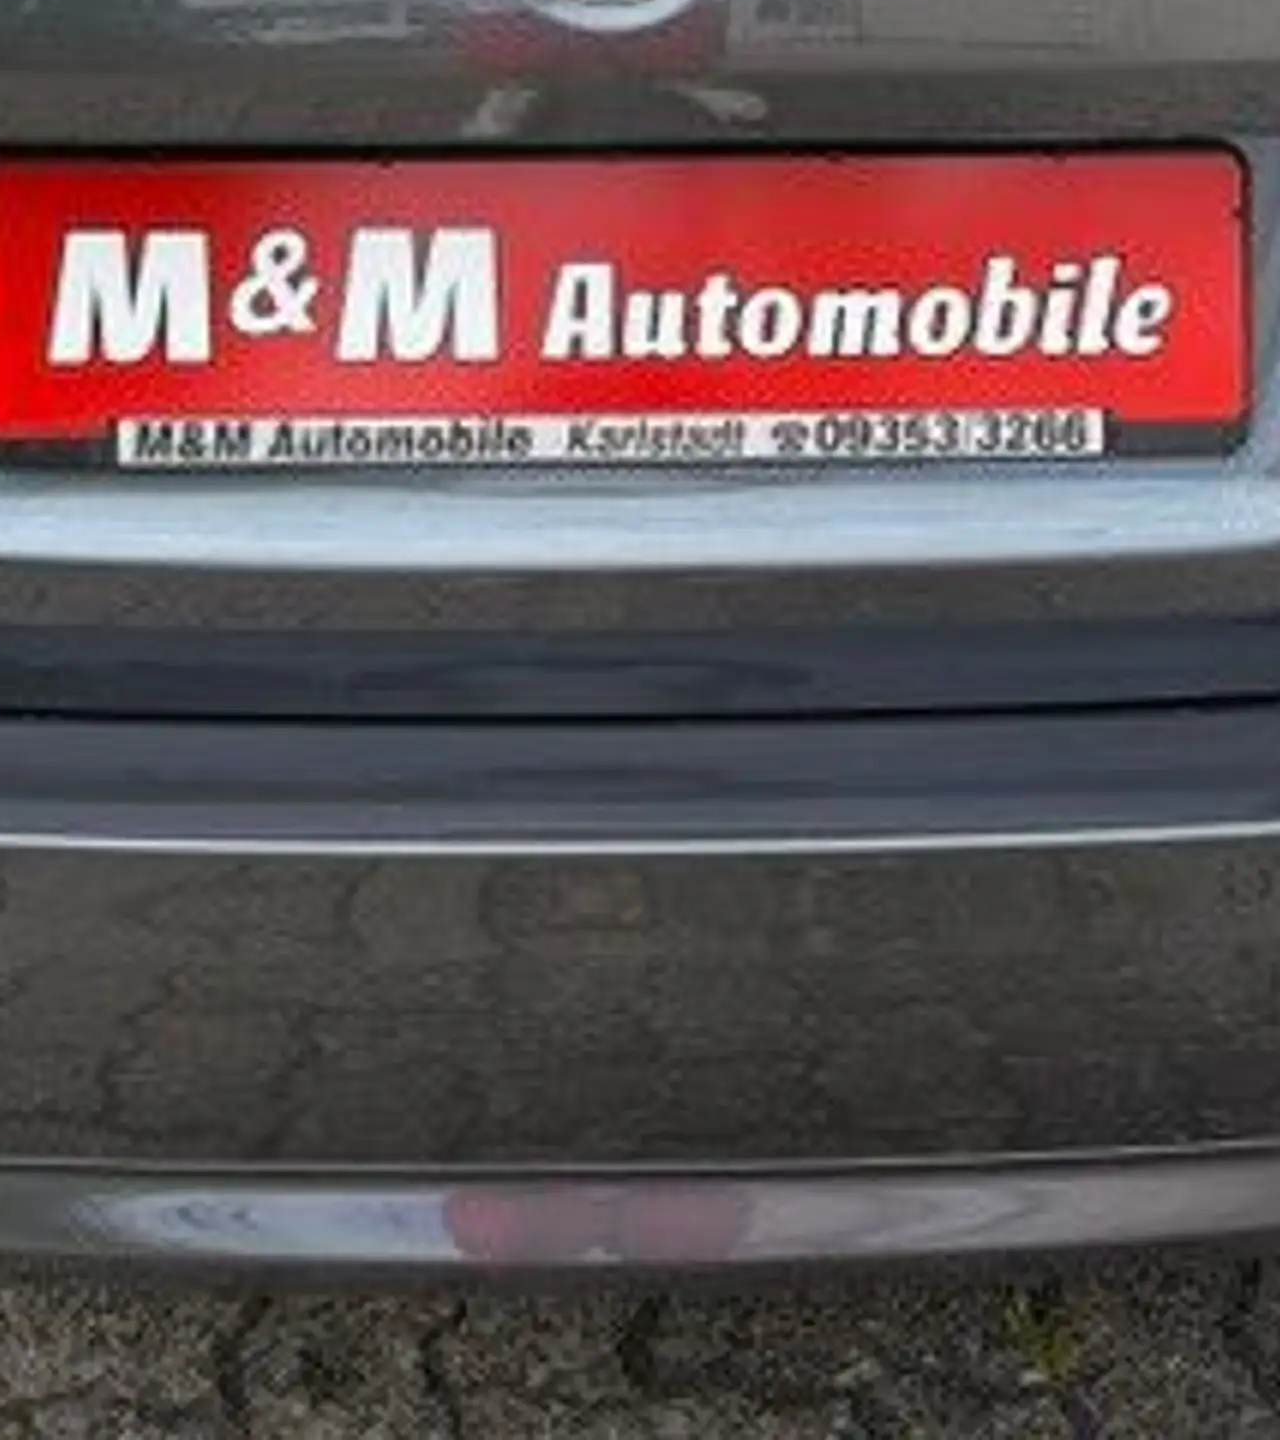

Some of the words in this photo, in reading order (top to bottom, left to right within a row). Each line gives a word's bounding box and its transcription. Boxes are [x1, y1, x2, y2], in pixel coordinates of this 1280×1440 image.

[48, 229, 499, 363] M&M
[540, 256, 1171, 358] Automobile
[135, 422, 253, 458] M&M
[268, 417, 534, 458] Automobile
